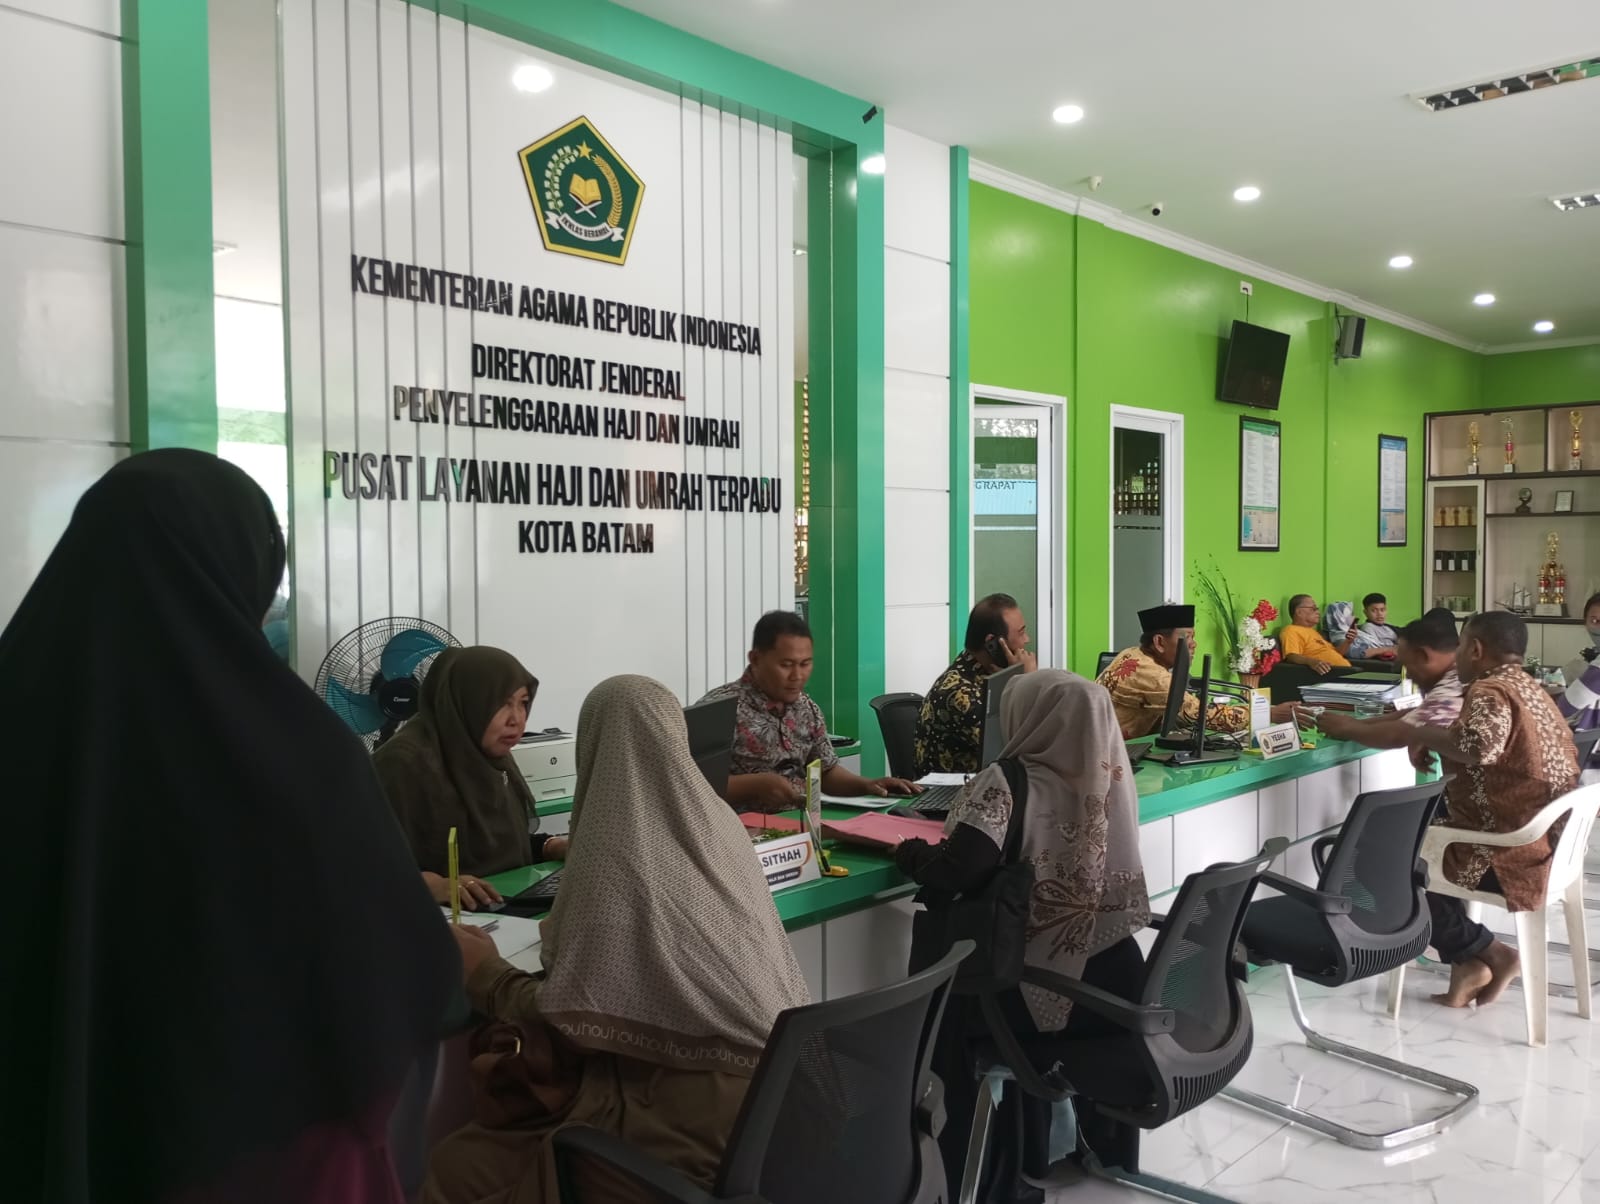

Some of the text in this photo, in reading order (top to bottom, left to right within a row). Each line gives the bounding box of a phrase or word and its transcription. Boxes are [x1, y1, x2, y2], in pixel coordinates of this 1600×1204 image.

[351, 254, 761, 356] KEMENTERIAN AGAMA REPUBLIK INDONESIA
[472, 343, 686, 401] DIREKTORAT JENDERAL
[394, 385, 740, 449] PENYELENGGARAAN HAJI DAN UMRAH
[324, 450, 781, 513] PUSAT LAYANAN HAJI DAN UMRAH TERPADU
[518, 520, 654, 554] KOTA BATAM
